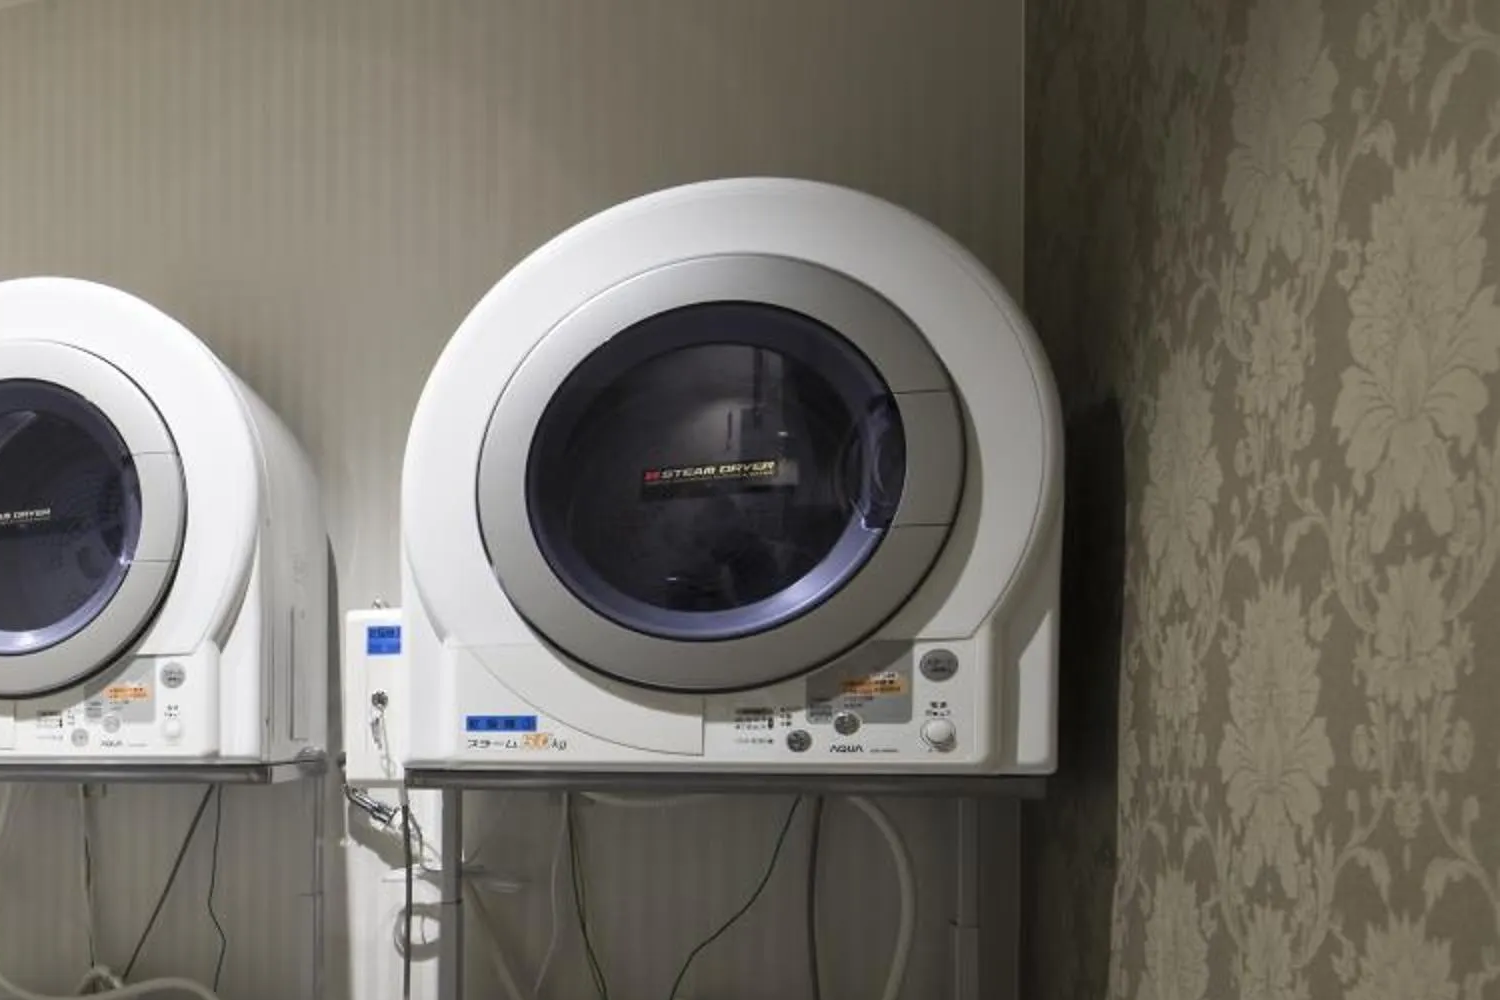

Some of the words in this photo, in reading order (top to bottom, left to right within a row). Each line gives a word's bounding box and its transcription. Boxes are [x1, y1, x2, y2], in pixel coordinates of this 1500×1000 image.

[660, 465, 716, 479] STEAM
[719, 461, 776, 474] DRYER
[829, 744, 863, 753] AQUA
